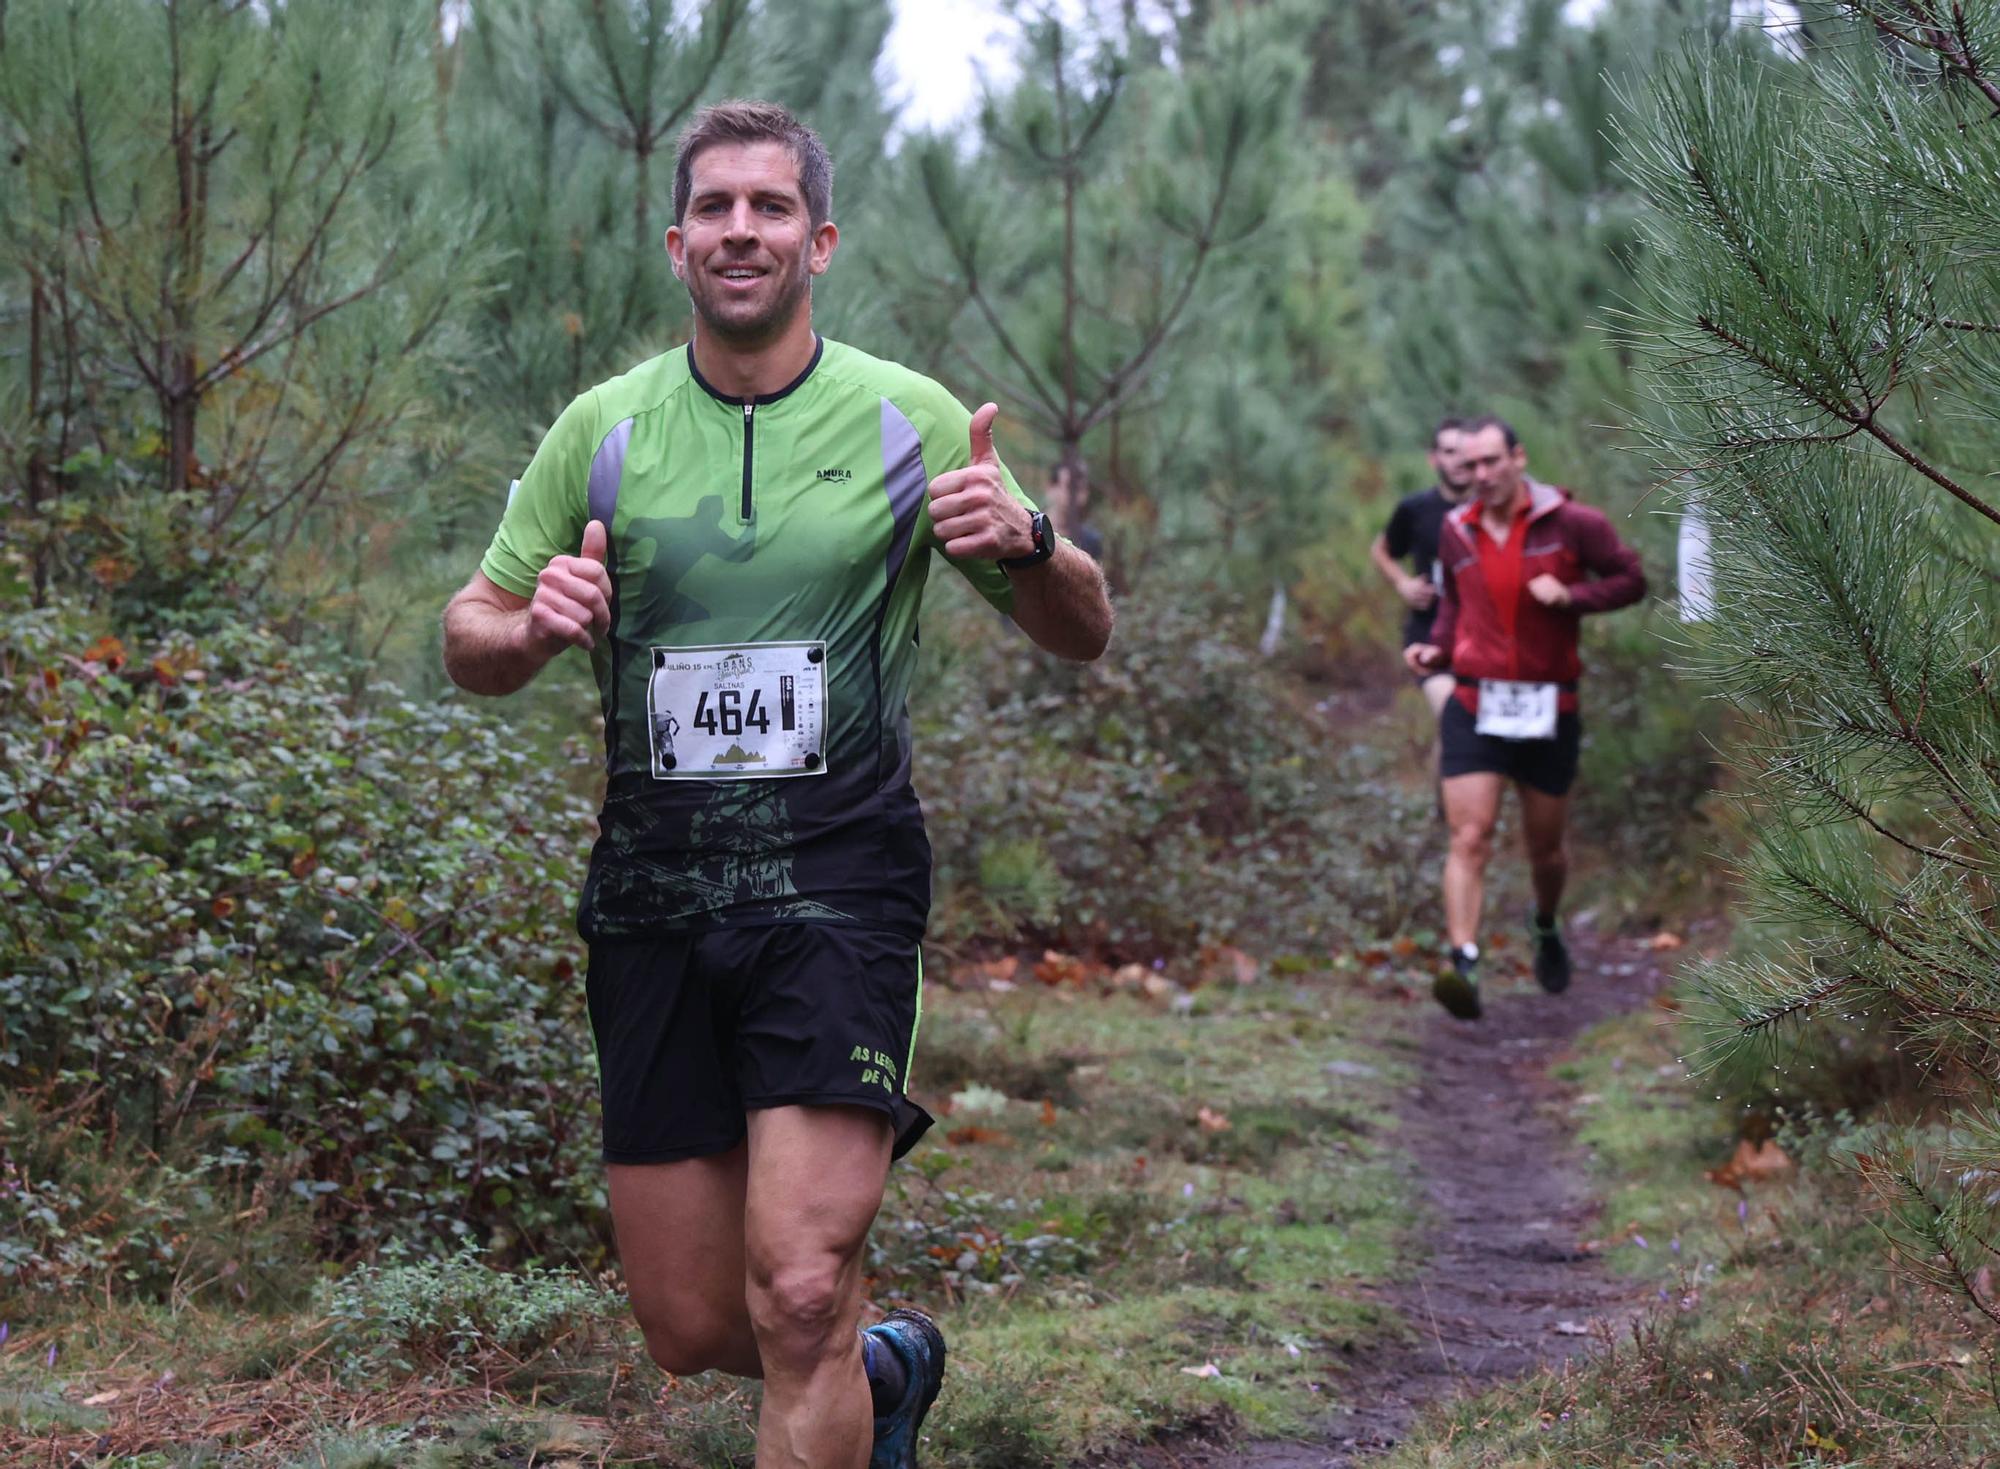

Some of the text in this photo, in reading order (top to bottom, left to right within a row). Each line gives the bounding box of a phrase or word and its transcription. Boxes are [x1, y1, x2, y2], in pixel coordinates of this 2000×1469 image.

[816, 469, 852, 479] AMURA
[693, 663, 702, 671] 15
[716, 656, 753, 671] TRANS
[694, 689, 769, 736] 464
[850, 1045, 870, 1061] AS
[862, 1069, 880, 1083] DE
